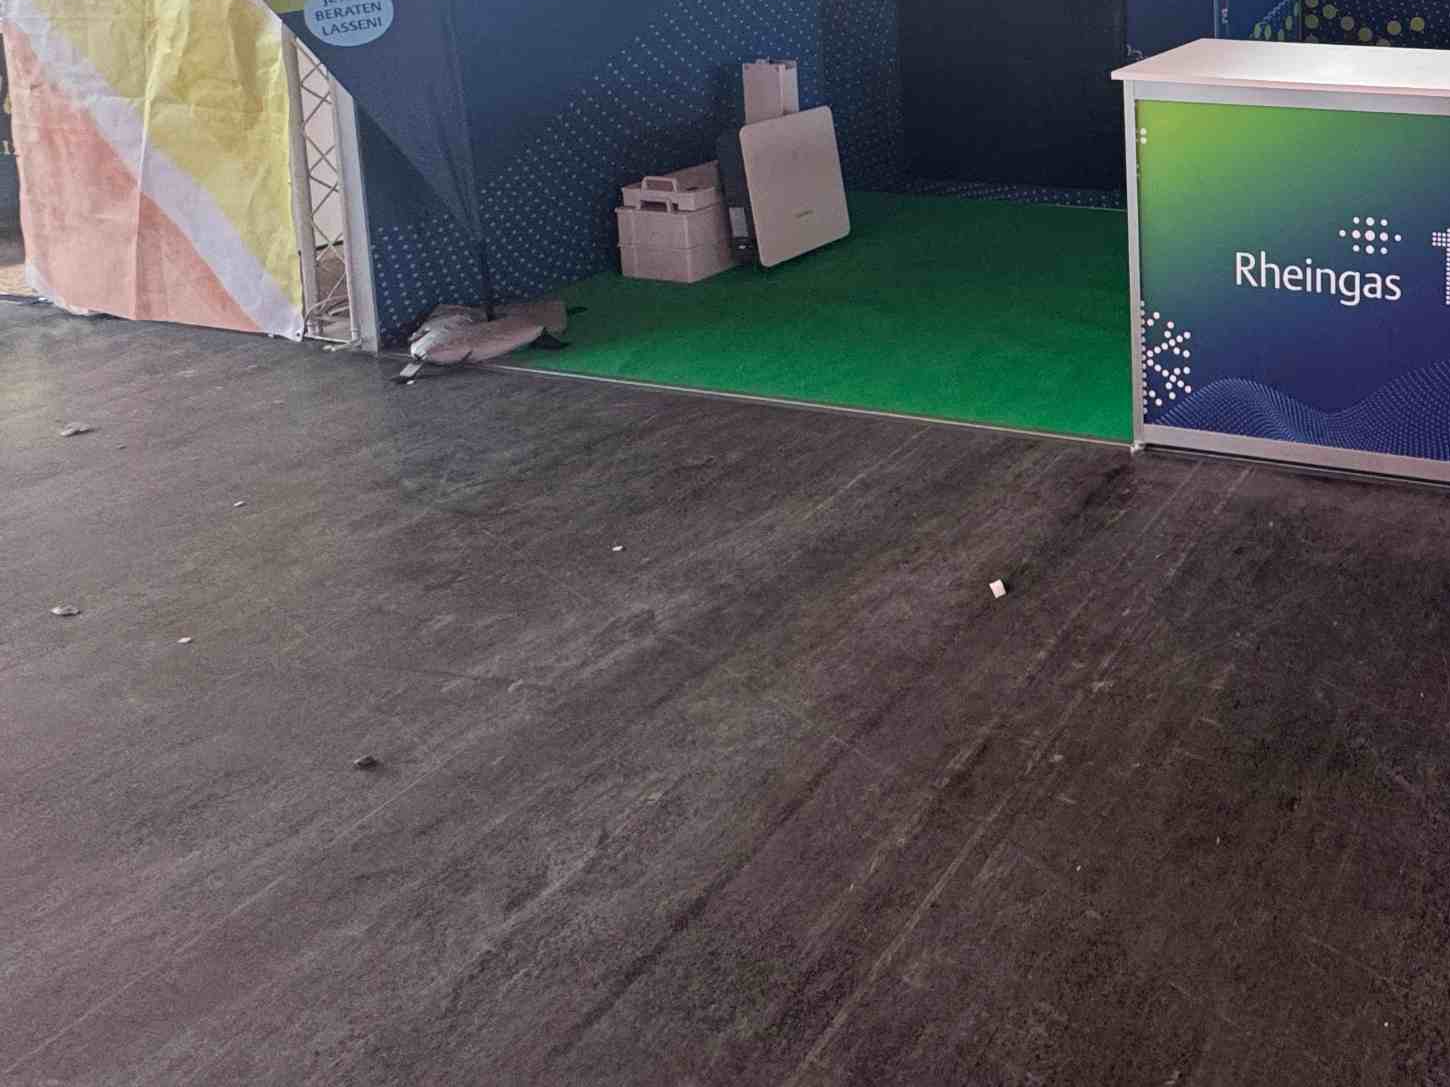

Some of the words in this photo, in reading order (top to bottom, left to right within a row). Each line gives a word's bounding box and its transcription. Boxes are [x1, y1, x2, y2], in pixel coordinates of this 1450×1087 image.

[315, 2, 382, 22] BERATEN
[321, 16, 383, 37] LASSEN!
[1234, 250, 1402, 307] Rheingas
